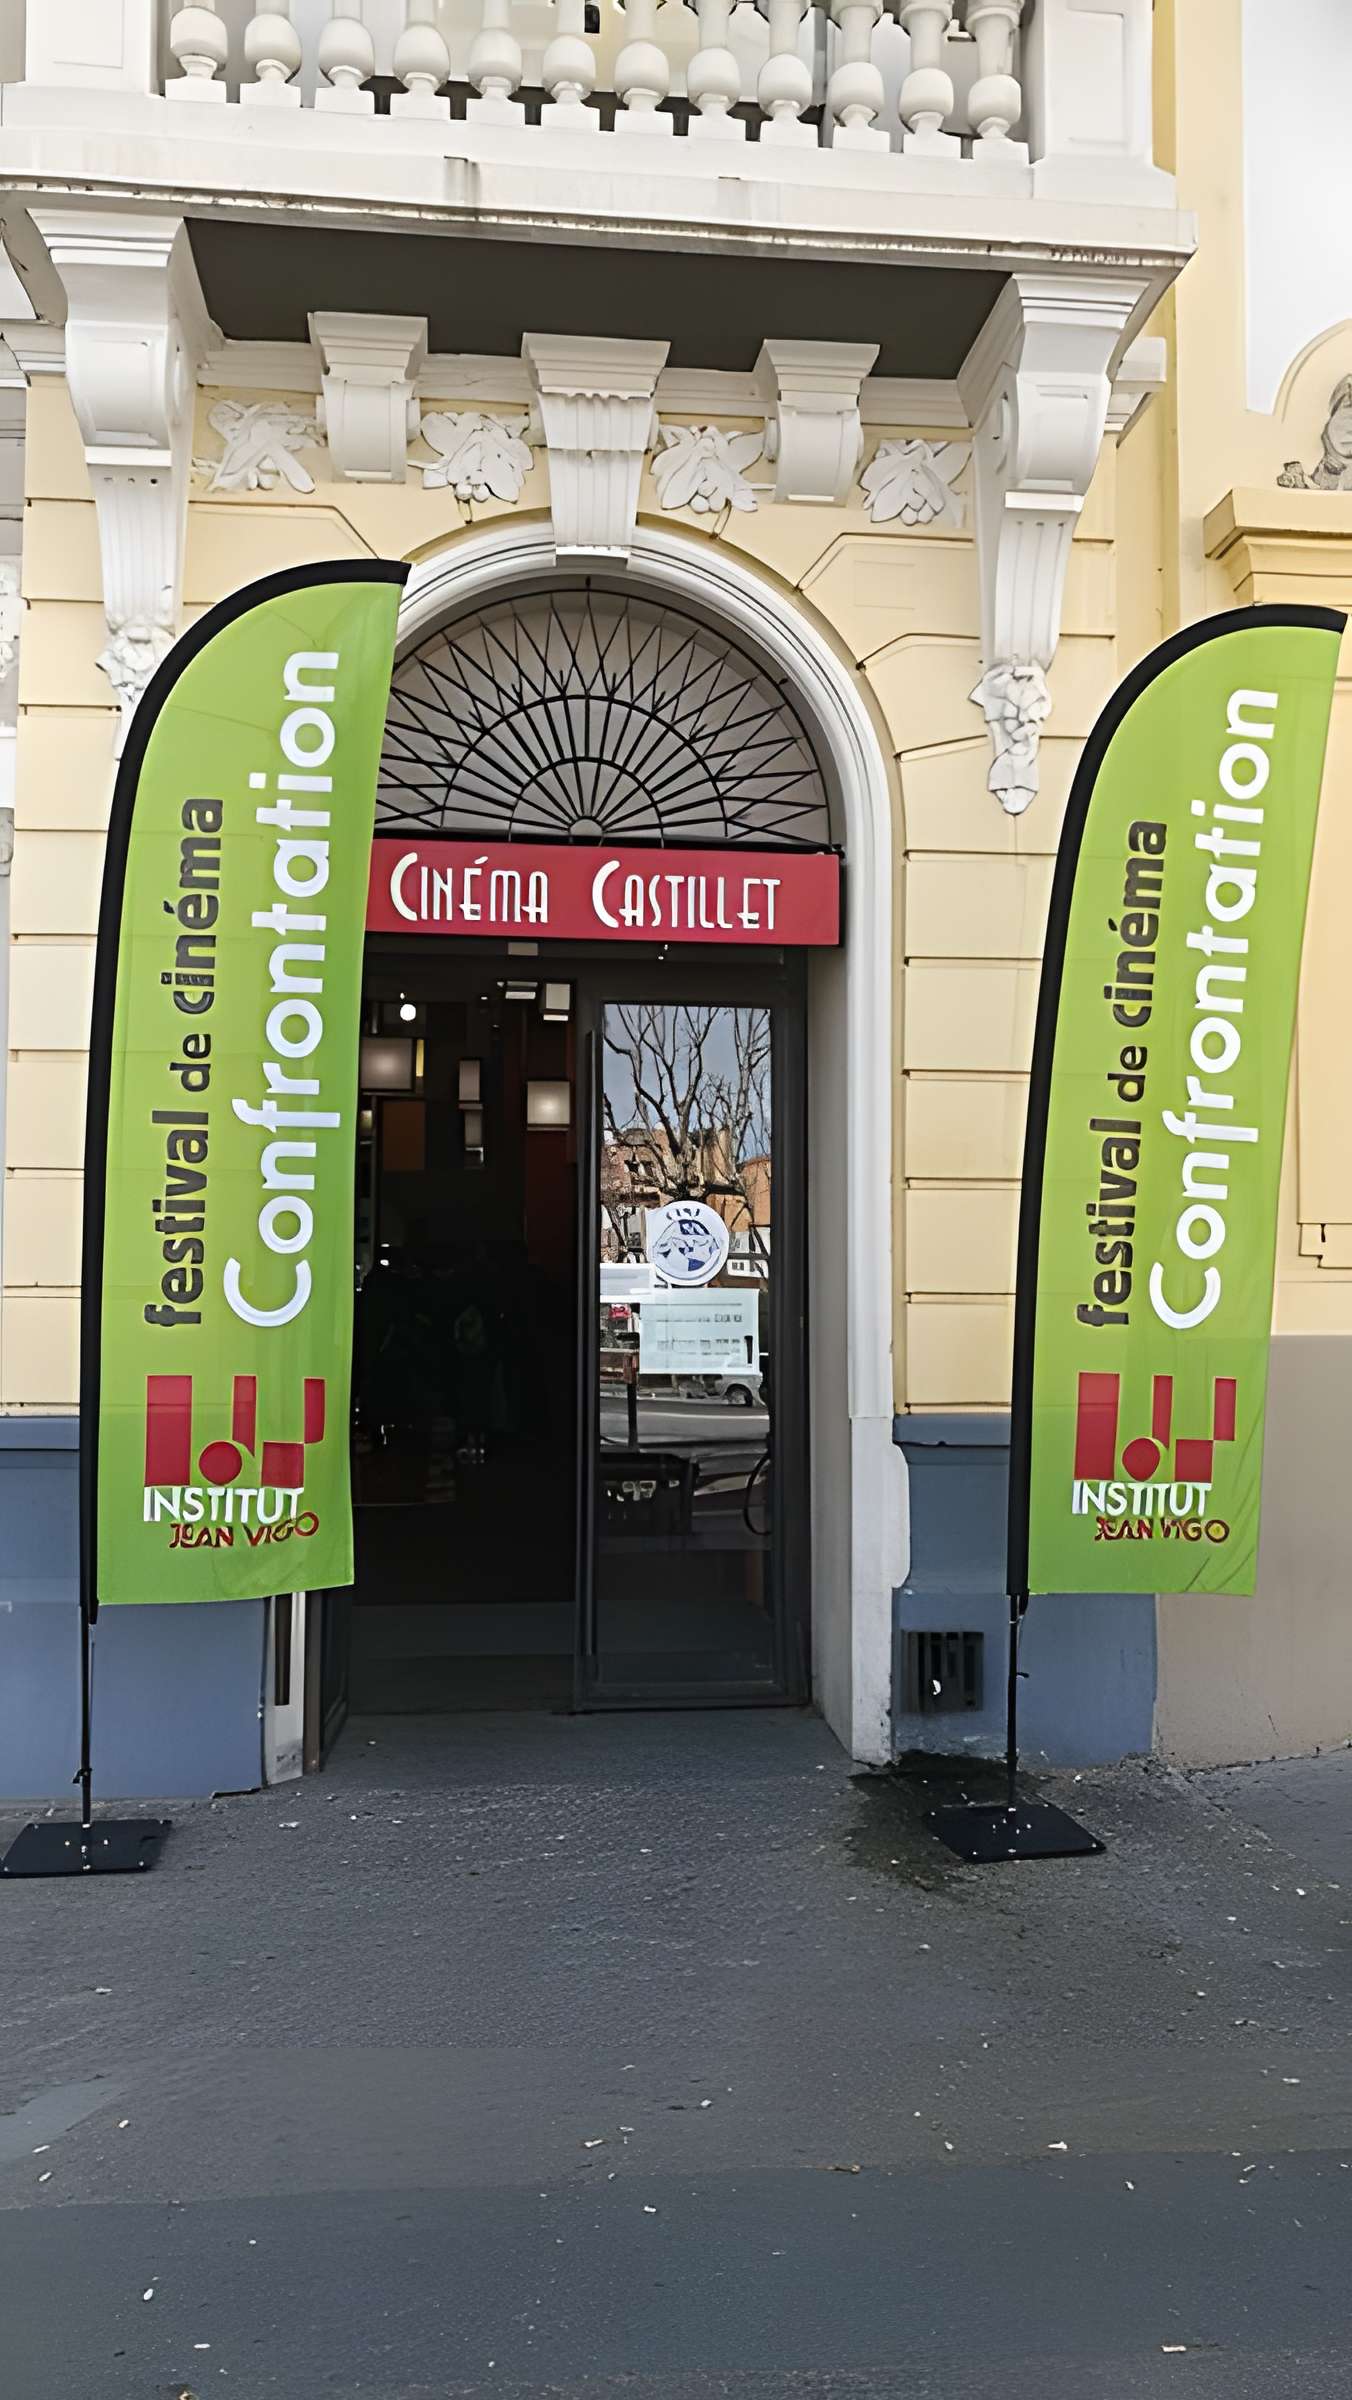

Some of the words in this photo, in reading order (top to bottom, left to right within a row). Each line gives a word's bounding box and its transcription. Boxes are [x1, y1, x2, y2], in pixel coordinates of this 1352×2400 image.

[160, 797, 224, 1015] cinéma
[390, 852, 549, 924] CINÉMA
[591, 860, 782, 930] CASTILLET
[1104, 820, 1168, 1028] cinéma
[223, 651, 340, 1328] Confrontation
[1149, 688, 1279, 1329] Confrontation
[169, 1033, 212, 1093] de
[1107, 1045, 1148, 1102] de
[144, 1110, 209, 1328] festival
[1077, 1118, 1141, 1327] festival
[143, 1487, 305, 1523] INSTITUT
[169, 1522, 235, 1549] JEAN
[242, 1511, 320, 1547] VIGO
[1072, 1480, 1213, 1517] INSTITUT
